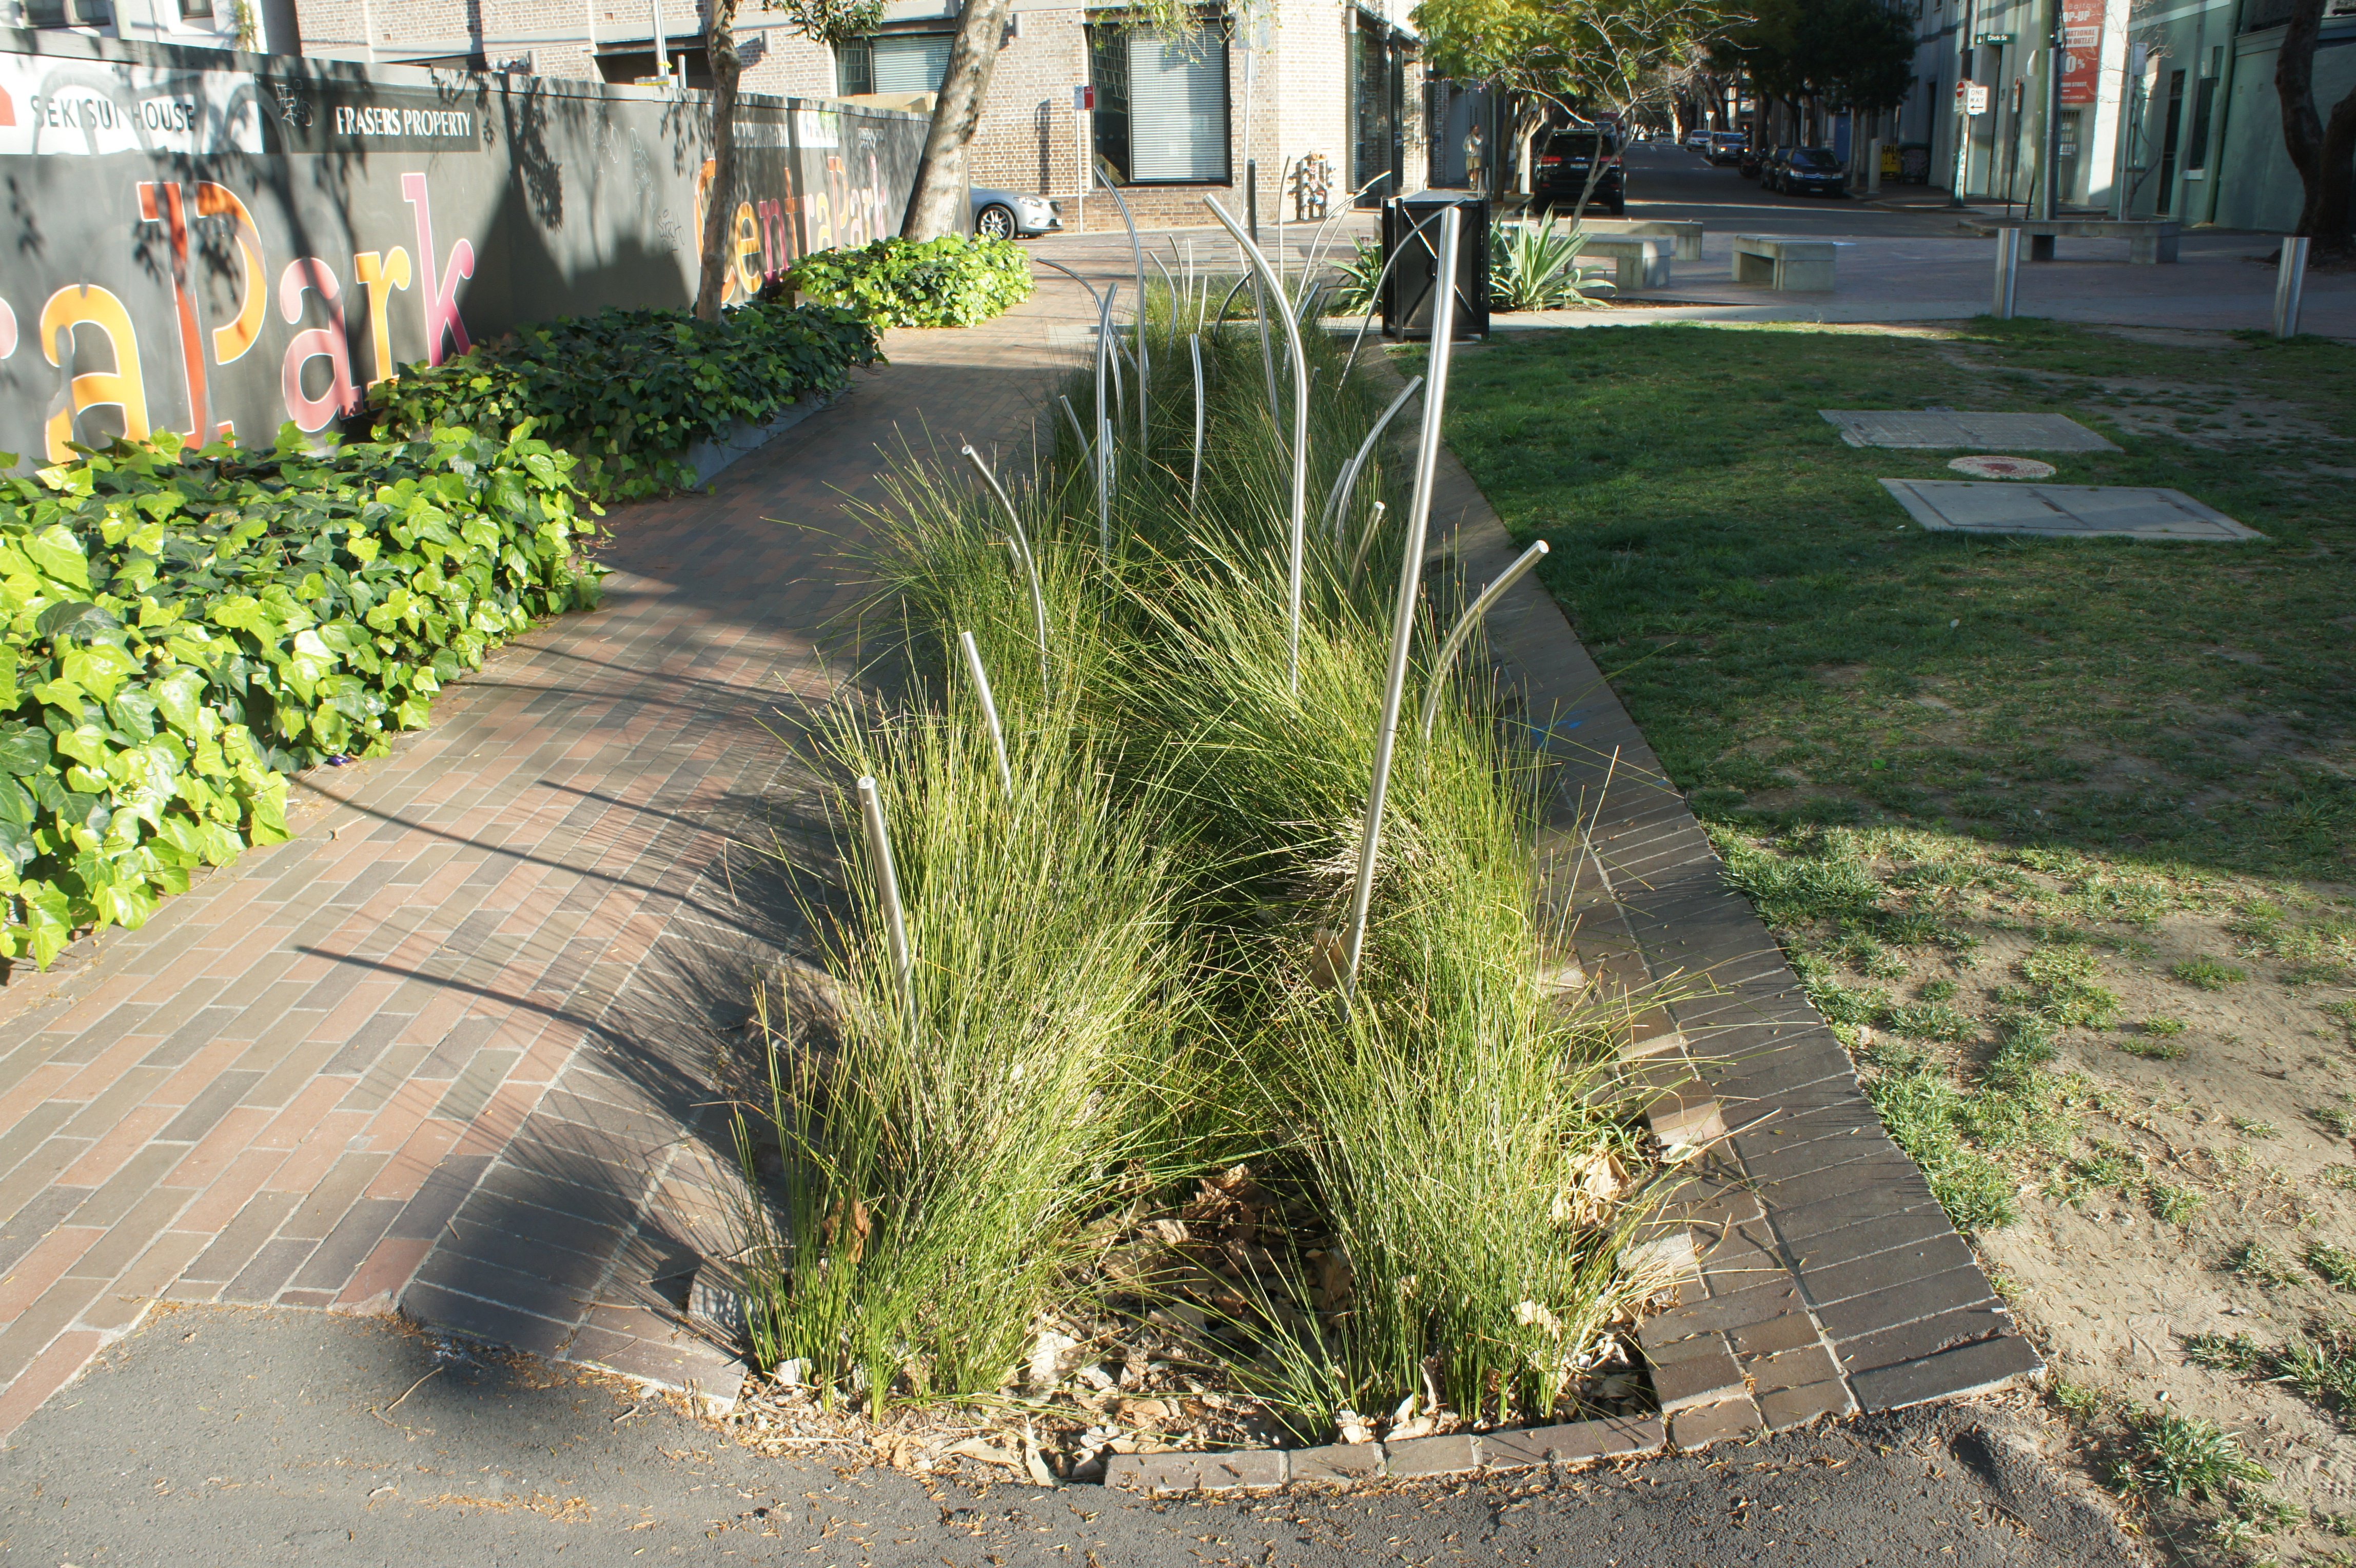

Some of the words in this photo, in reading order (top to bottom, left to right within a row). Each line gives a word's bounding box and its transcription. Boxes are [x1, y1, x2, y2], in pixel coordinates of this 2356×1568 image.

[30, 94, 120, 130] SEKISUI
[132, 101, 194, 132] HOUSE
[336, 106, 401, 136] FRASERS
[403, 109, 471, 137] PROPERTY
